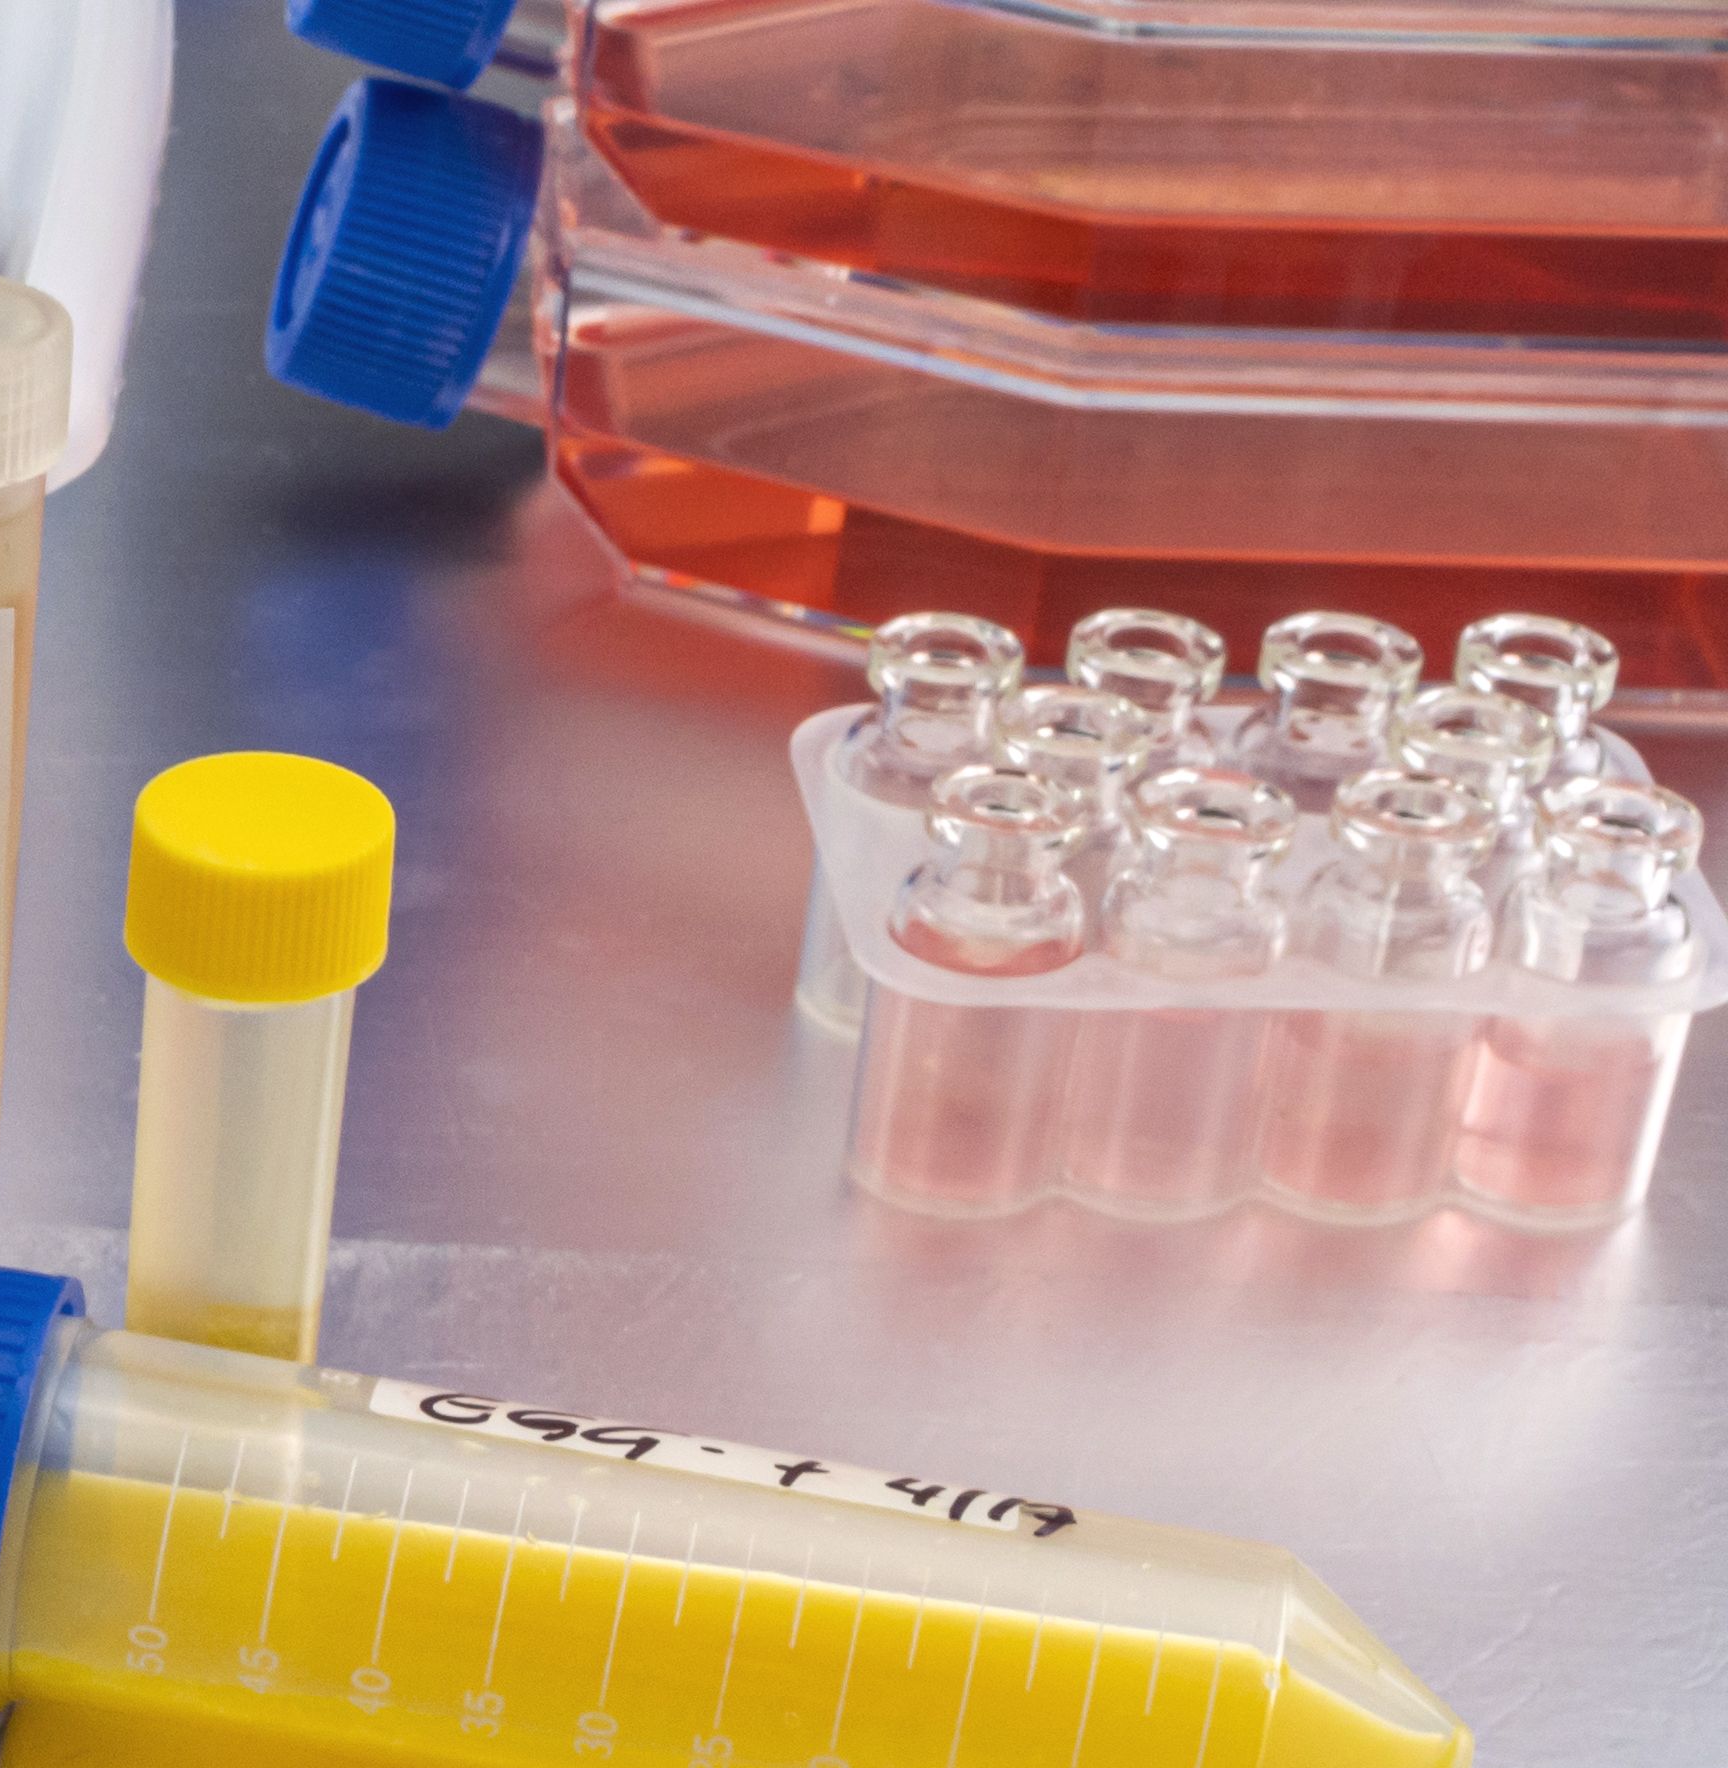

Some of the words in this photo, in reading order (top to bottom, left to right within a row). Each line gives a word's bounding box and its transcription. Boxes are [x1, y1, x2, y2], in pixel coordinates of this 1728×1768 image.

[127, 1624, 169, 1676] 50
[238, 1646, 280, 1695] 45
[347, 1667, 392, 1715] 40
[460, 1690, 506, 1739] 35
[574, 1711, 619, 1760] 30
